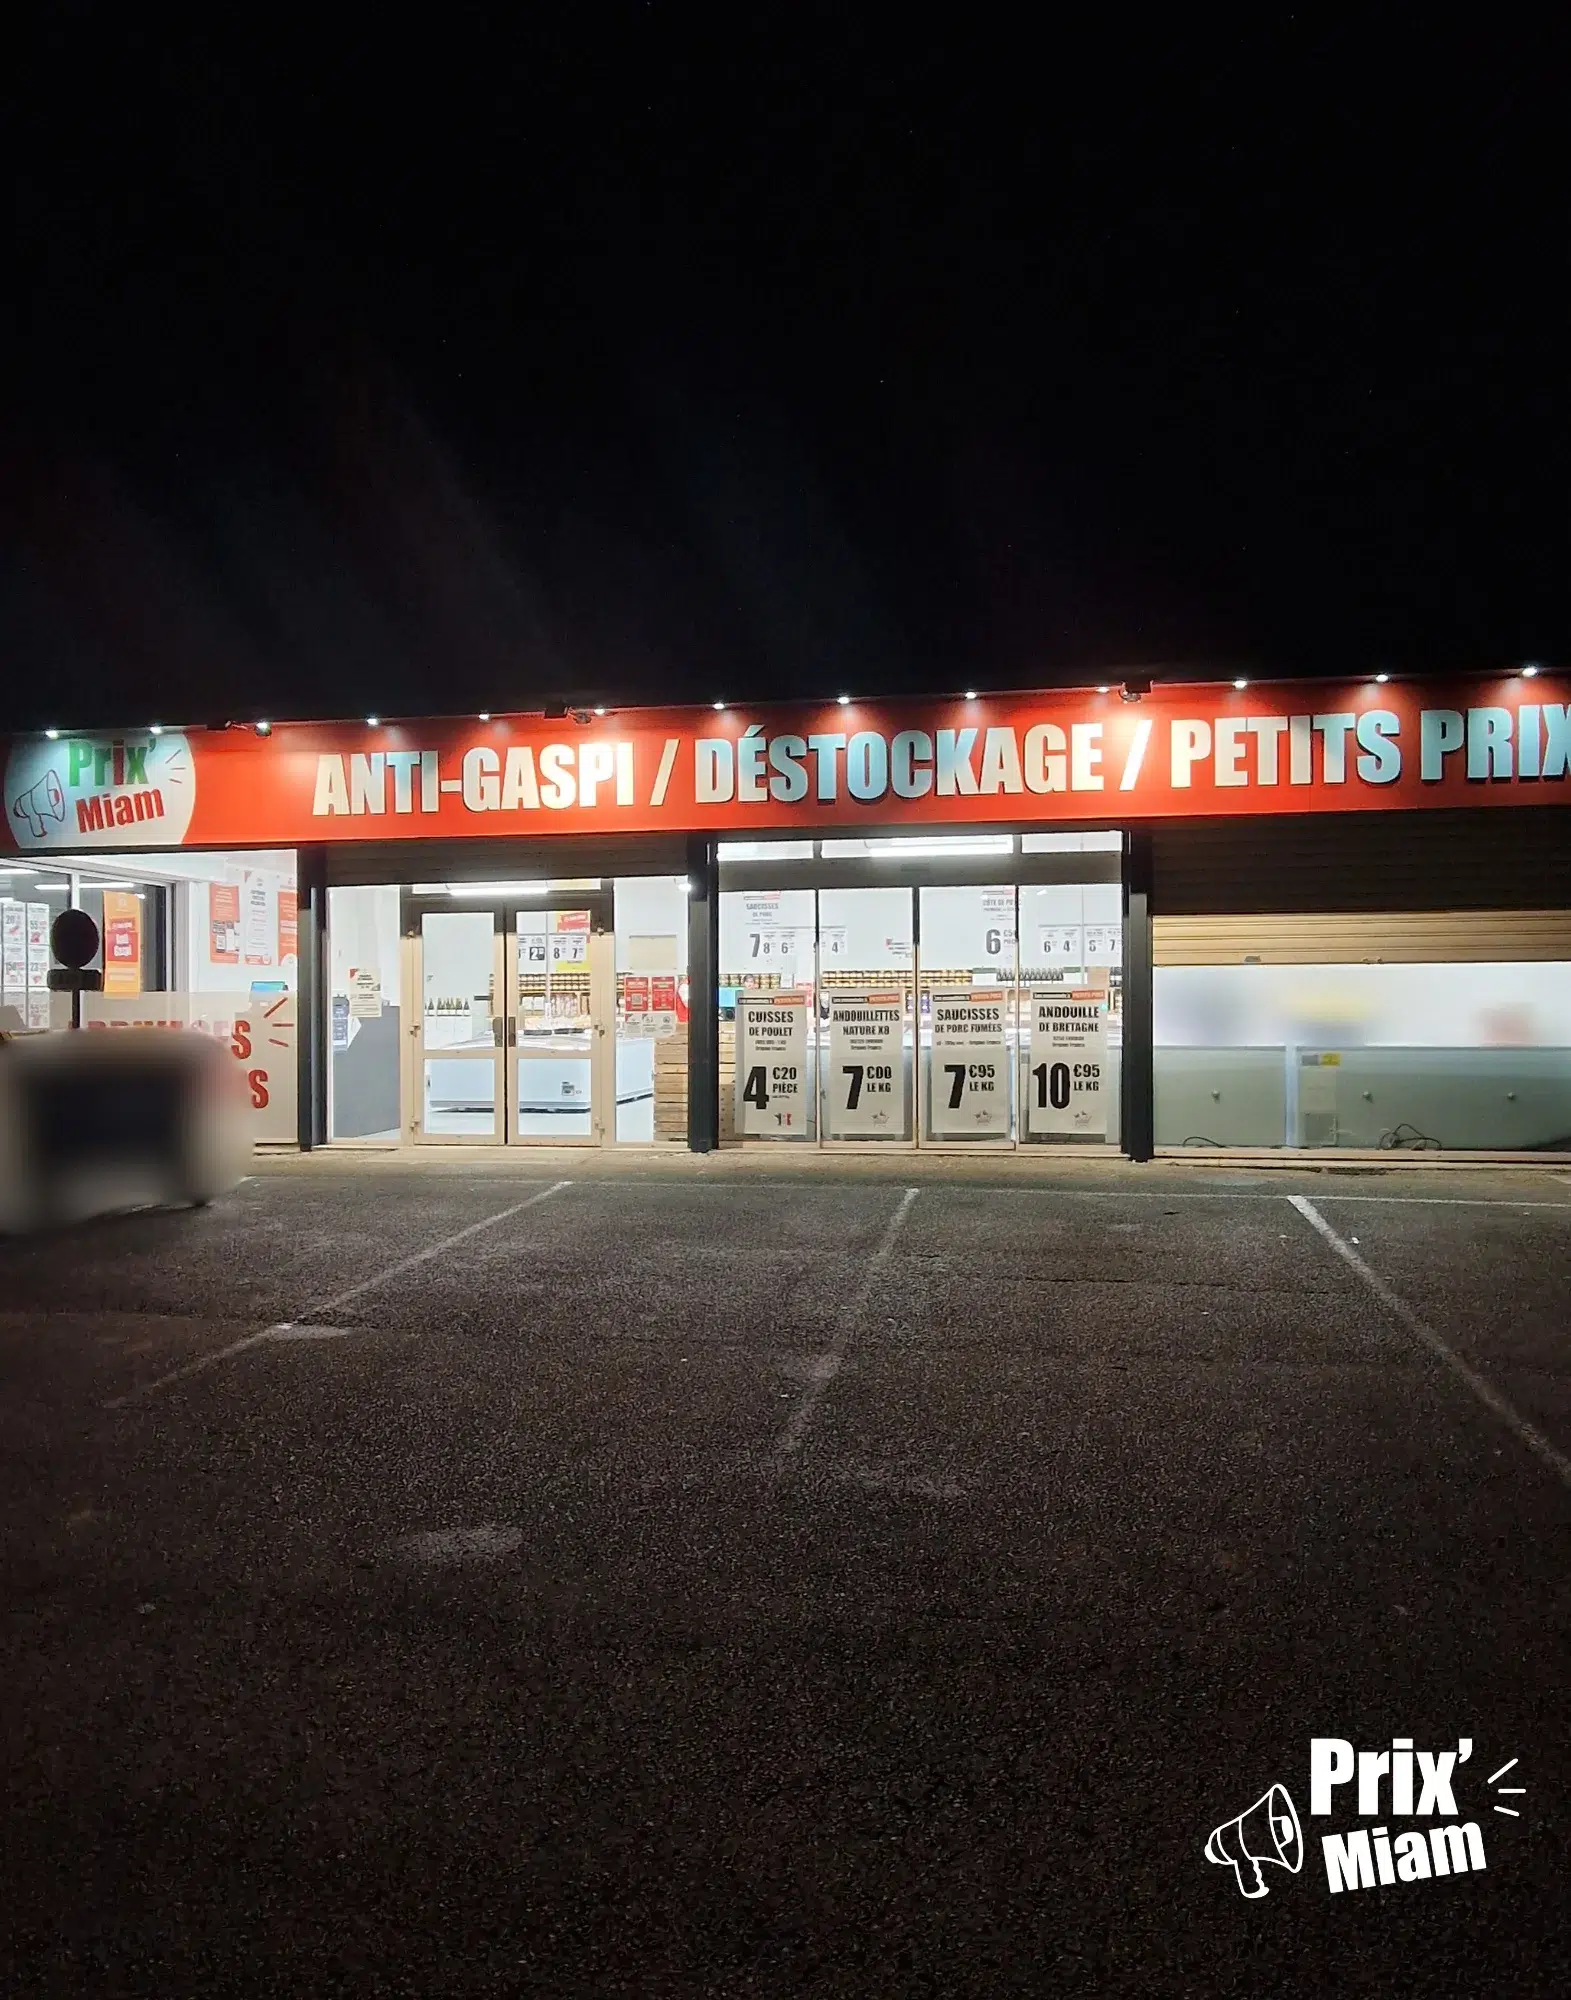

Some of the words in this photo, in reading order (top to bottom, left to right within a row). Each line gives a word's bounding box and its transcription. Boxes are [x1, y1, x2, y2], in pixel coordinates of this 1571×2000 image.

[313, 742, 634, 816] ANTI-GASPI
[695, 725, 1104, 804] DÉSTOCKAGE
[1171, 710, 1401, 788] PETITS
[1421, 703, 1571, 780] PRIX
[75, 788, 165, 833] Miam
[749, 933, 760, 957] 7
[781, 942, 788, 954] 6
[831, 941, 838, 953] 4
[986, 929, 1001, 955] 6
[1044, 940, 1051, 953] 6
[1063, 940, 1070, 952] 4
[1109, 939, 1116, 951] 7
[553, 947, 560, 959] 8
[572, 947, 578, 959] 7
[748, 1010, 793, 1023] CUISSES
[832, 1010, 900, 1022] ANDOUILLETTES
[937, 1008, 1000, 1021] SAUCISSES
[1038, 1005, 1100, 1018] ANDOUILLE
[749, 1027, 759, 1036] DE
[762, 1027, 793, 1036] POULET
[842, 1025, 876, 1035] NATURE
[934, 1024, 945, 1033] DE
[946, 1024, 969, 1033] PORC
[971, 1022, 1002, 1033] FUMÉES
[1039, 1022, 1050, 1032] DE
[1052, 1022, 1100, 1032] BRETAGNE
[743, 1066, 769, 1110] 4
[772, 1066, 797, 1080] €20
[772, 1082, 798, 1094] PIÈCE
[842, 1065, 864, 1110] 7
[866, 1082, 876, 1092] LE
[878, 1082, 892, 1092] KG
[944, 1064, 966, 1109] 7
[969, 1064, 995, 1078] €95
[969, 1081, 979, 1091] LE
[981, 1081, 995, 1091] KG
[1032, 1062, 1071, 1109] 10
[1073, 1063, 1100, 1078] €95
[1073, 1080, 1083, 1091] LE
[1085, 1080, 1100, 1091] KG
